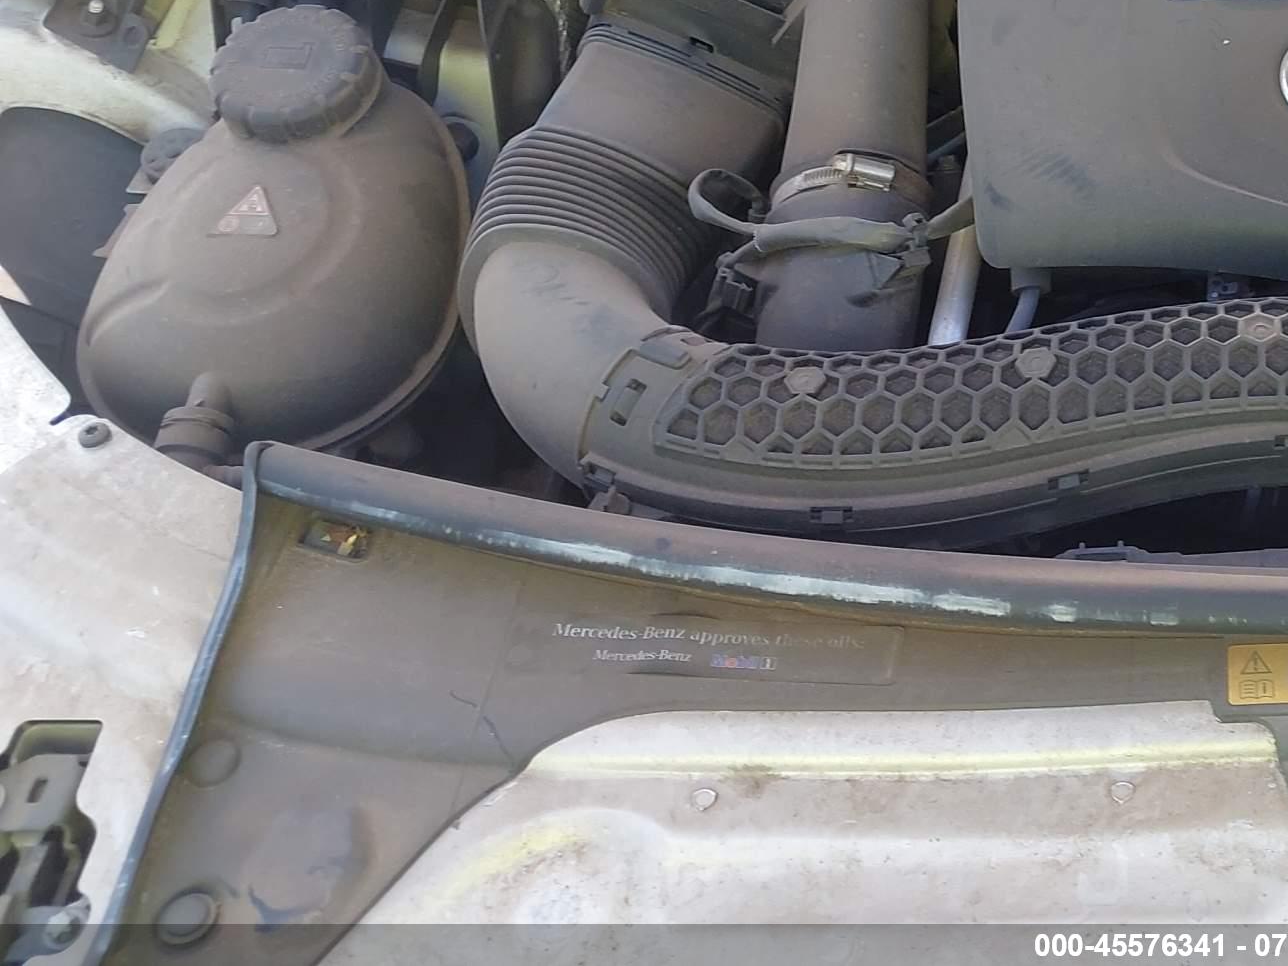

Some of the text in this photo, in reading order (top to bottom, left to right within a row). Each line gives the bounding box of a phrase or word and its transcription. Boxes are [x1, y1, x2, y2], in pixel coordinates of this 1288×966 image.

[552, 623, 686, 640] Mercedes-Benz
[690, 631, 769, 646] approves
[592, 649, 692, 662] Mercedes-Benz
